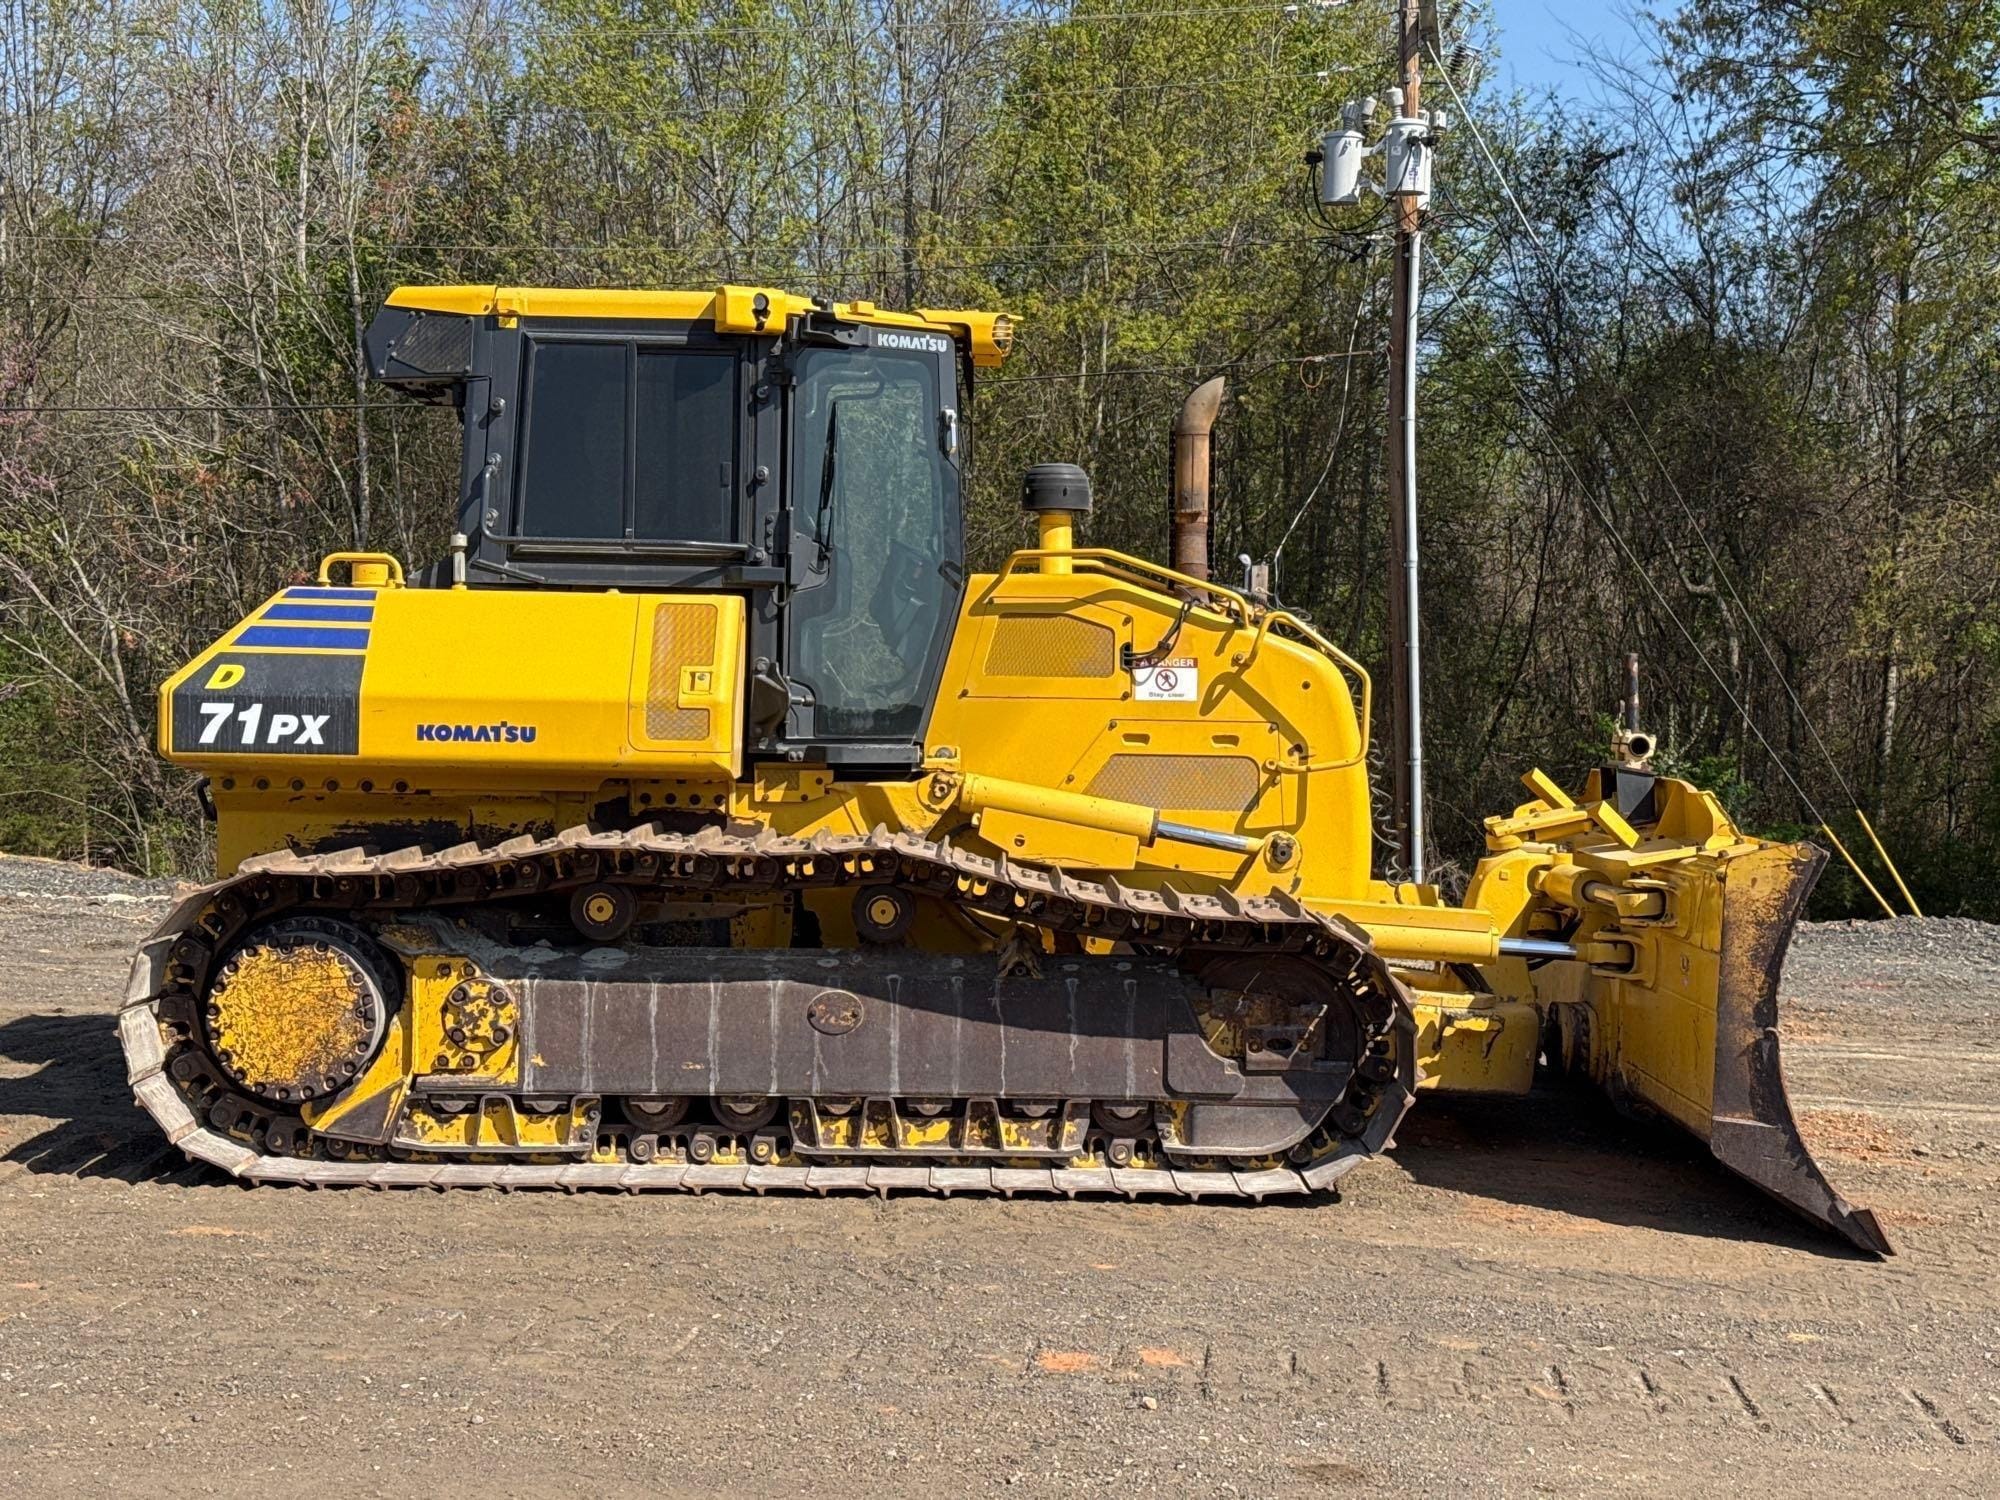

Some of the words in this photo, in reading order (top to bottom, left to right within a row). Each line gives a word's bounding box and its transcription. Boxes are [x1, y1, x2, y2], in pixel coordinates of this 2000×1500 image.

[877, 333, 947, 352] KOMATSU
[204, 664, 245, 689] D
[416, 720, 537, 743] KOMATSU
